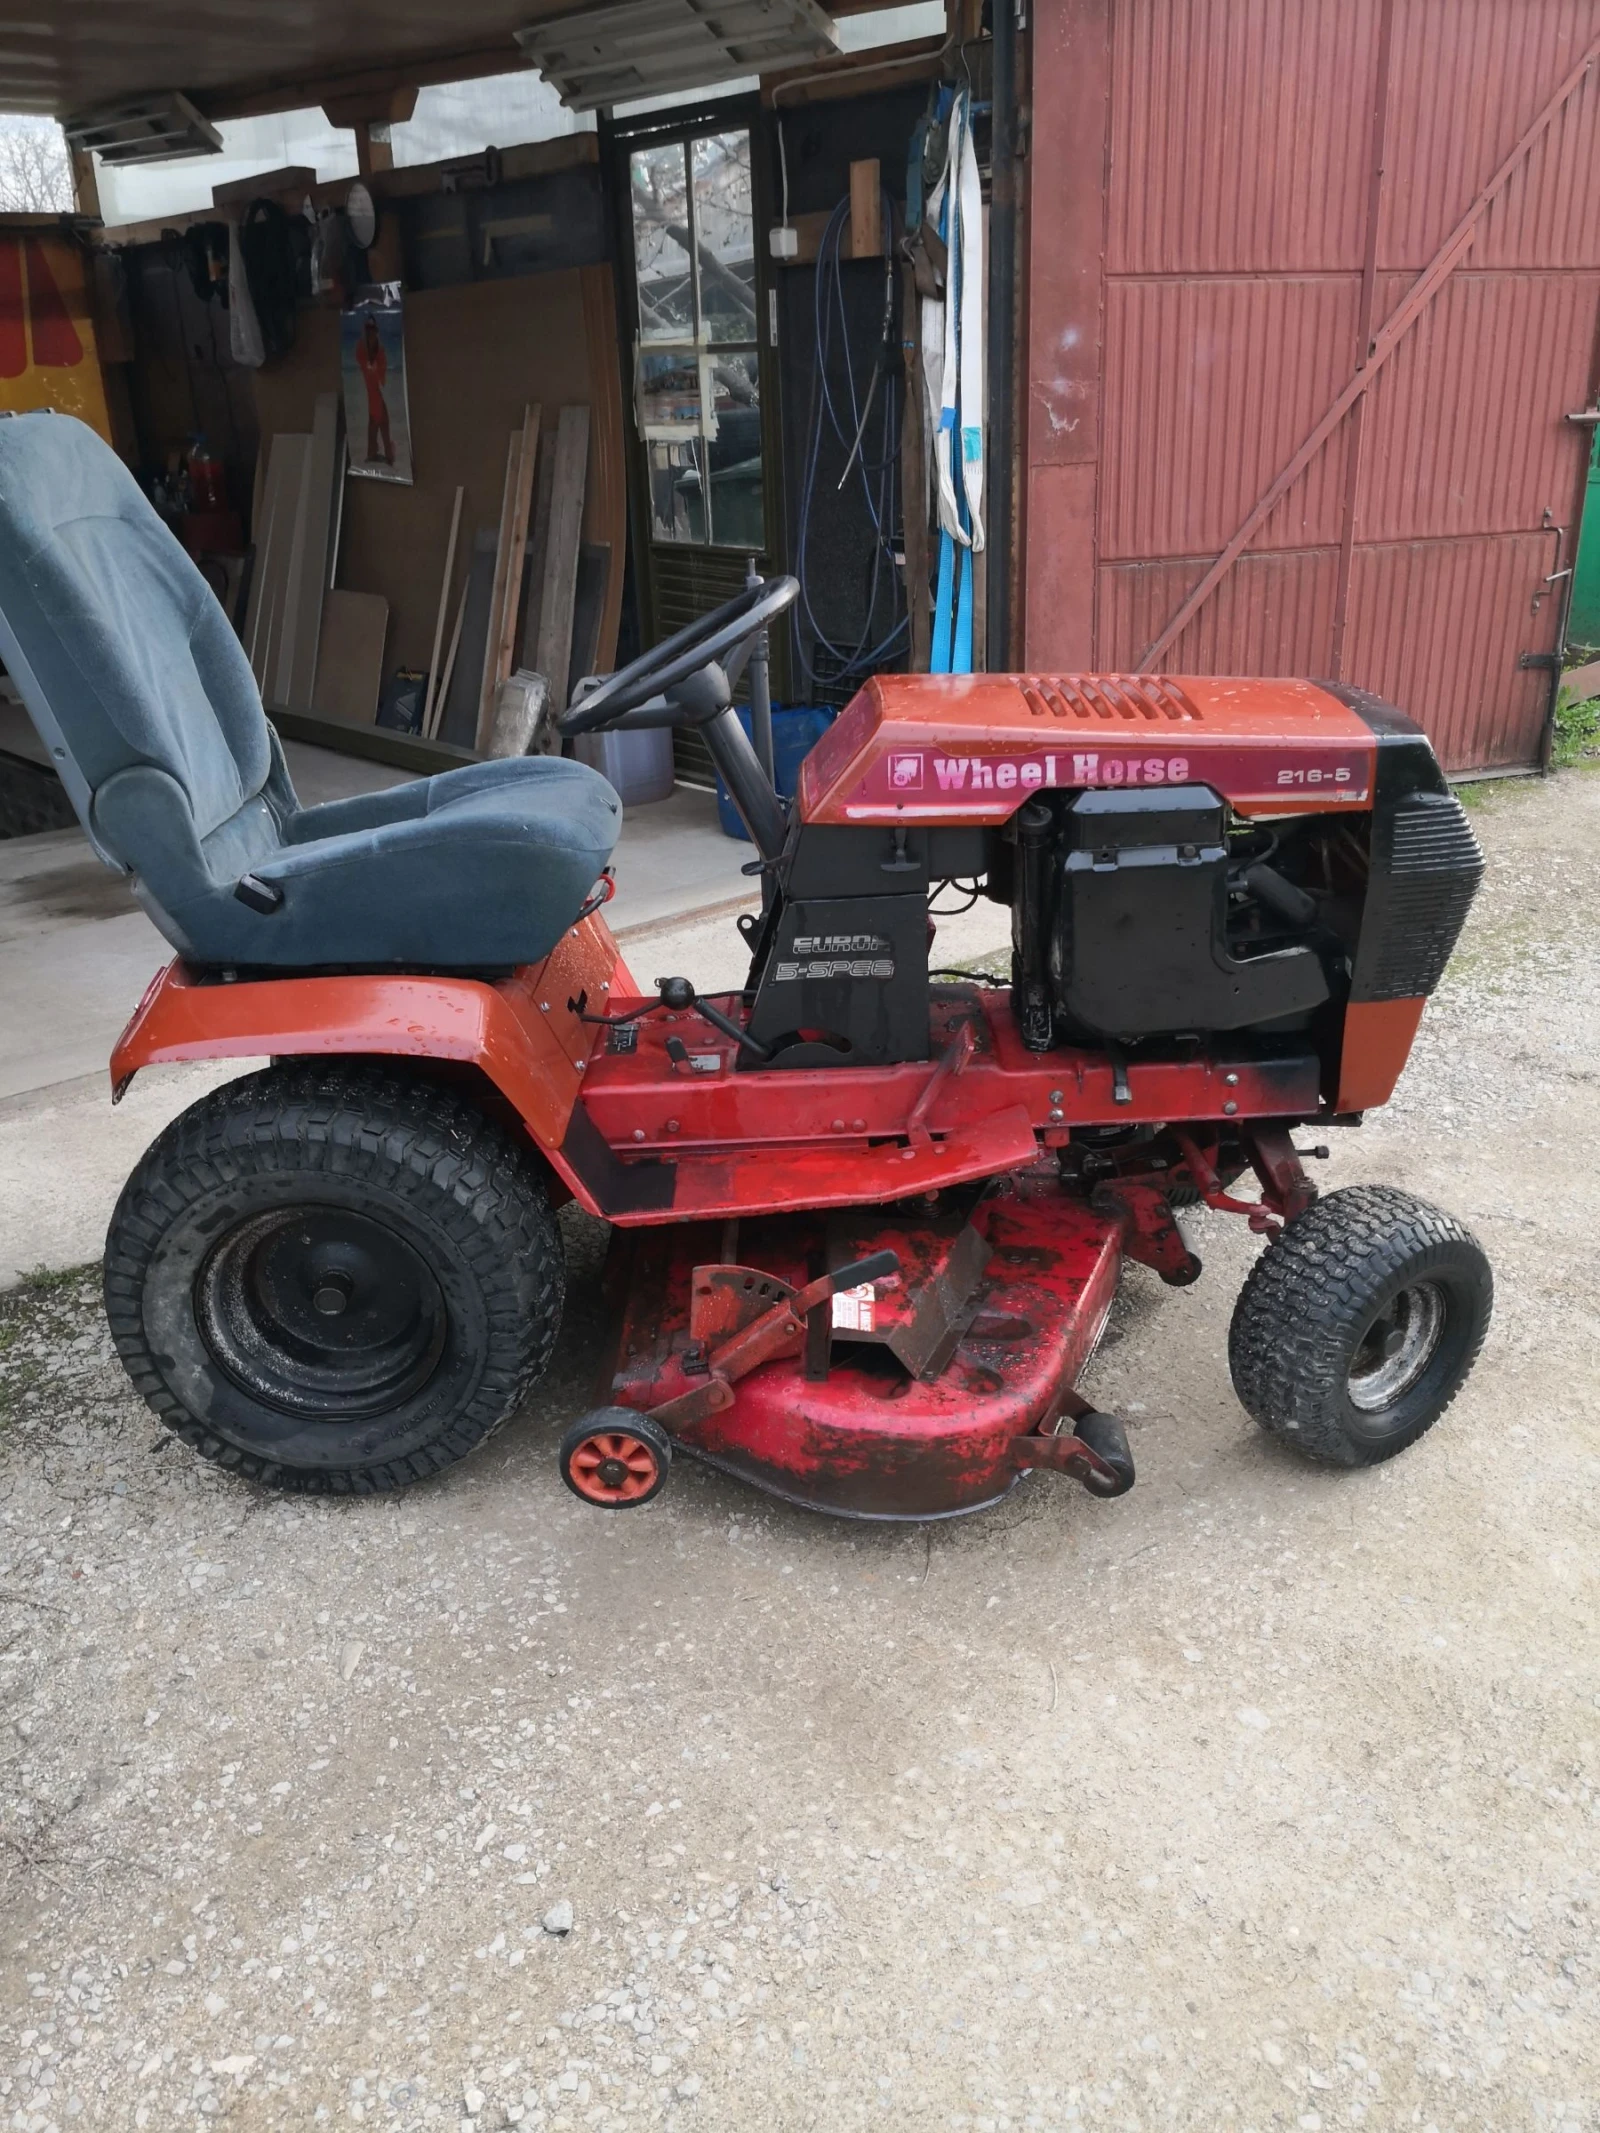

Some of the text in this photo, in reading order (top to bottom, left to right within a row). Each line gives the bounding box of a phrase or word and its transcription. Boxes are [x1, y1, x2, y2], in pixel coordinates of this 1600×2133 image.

[933, 753, 1189, 791] Wheel Horse
[1277, 767, 1351, 784] 216-5
[775, 959, 894, 981] 5-SPEE
